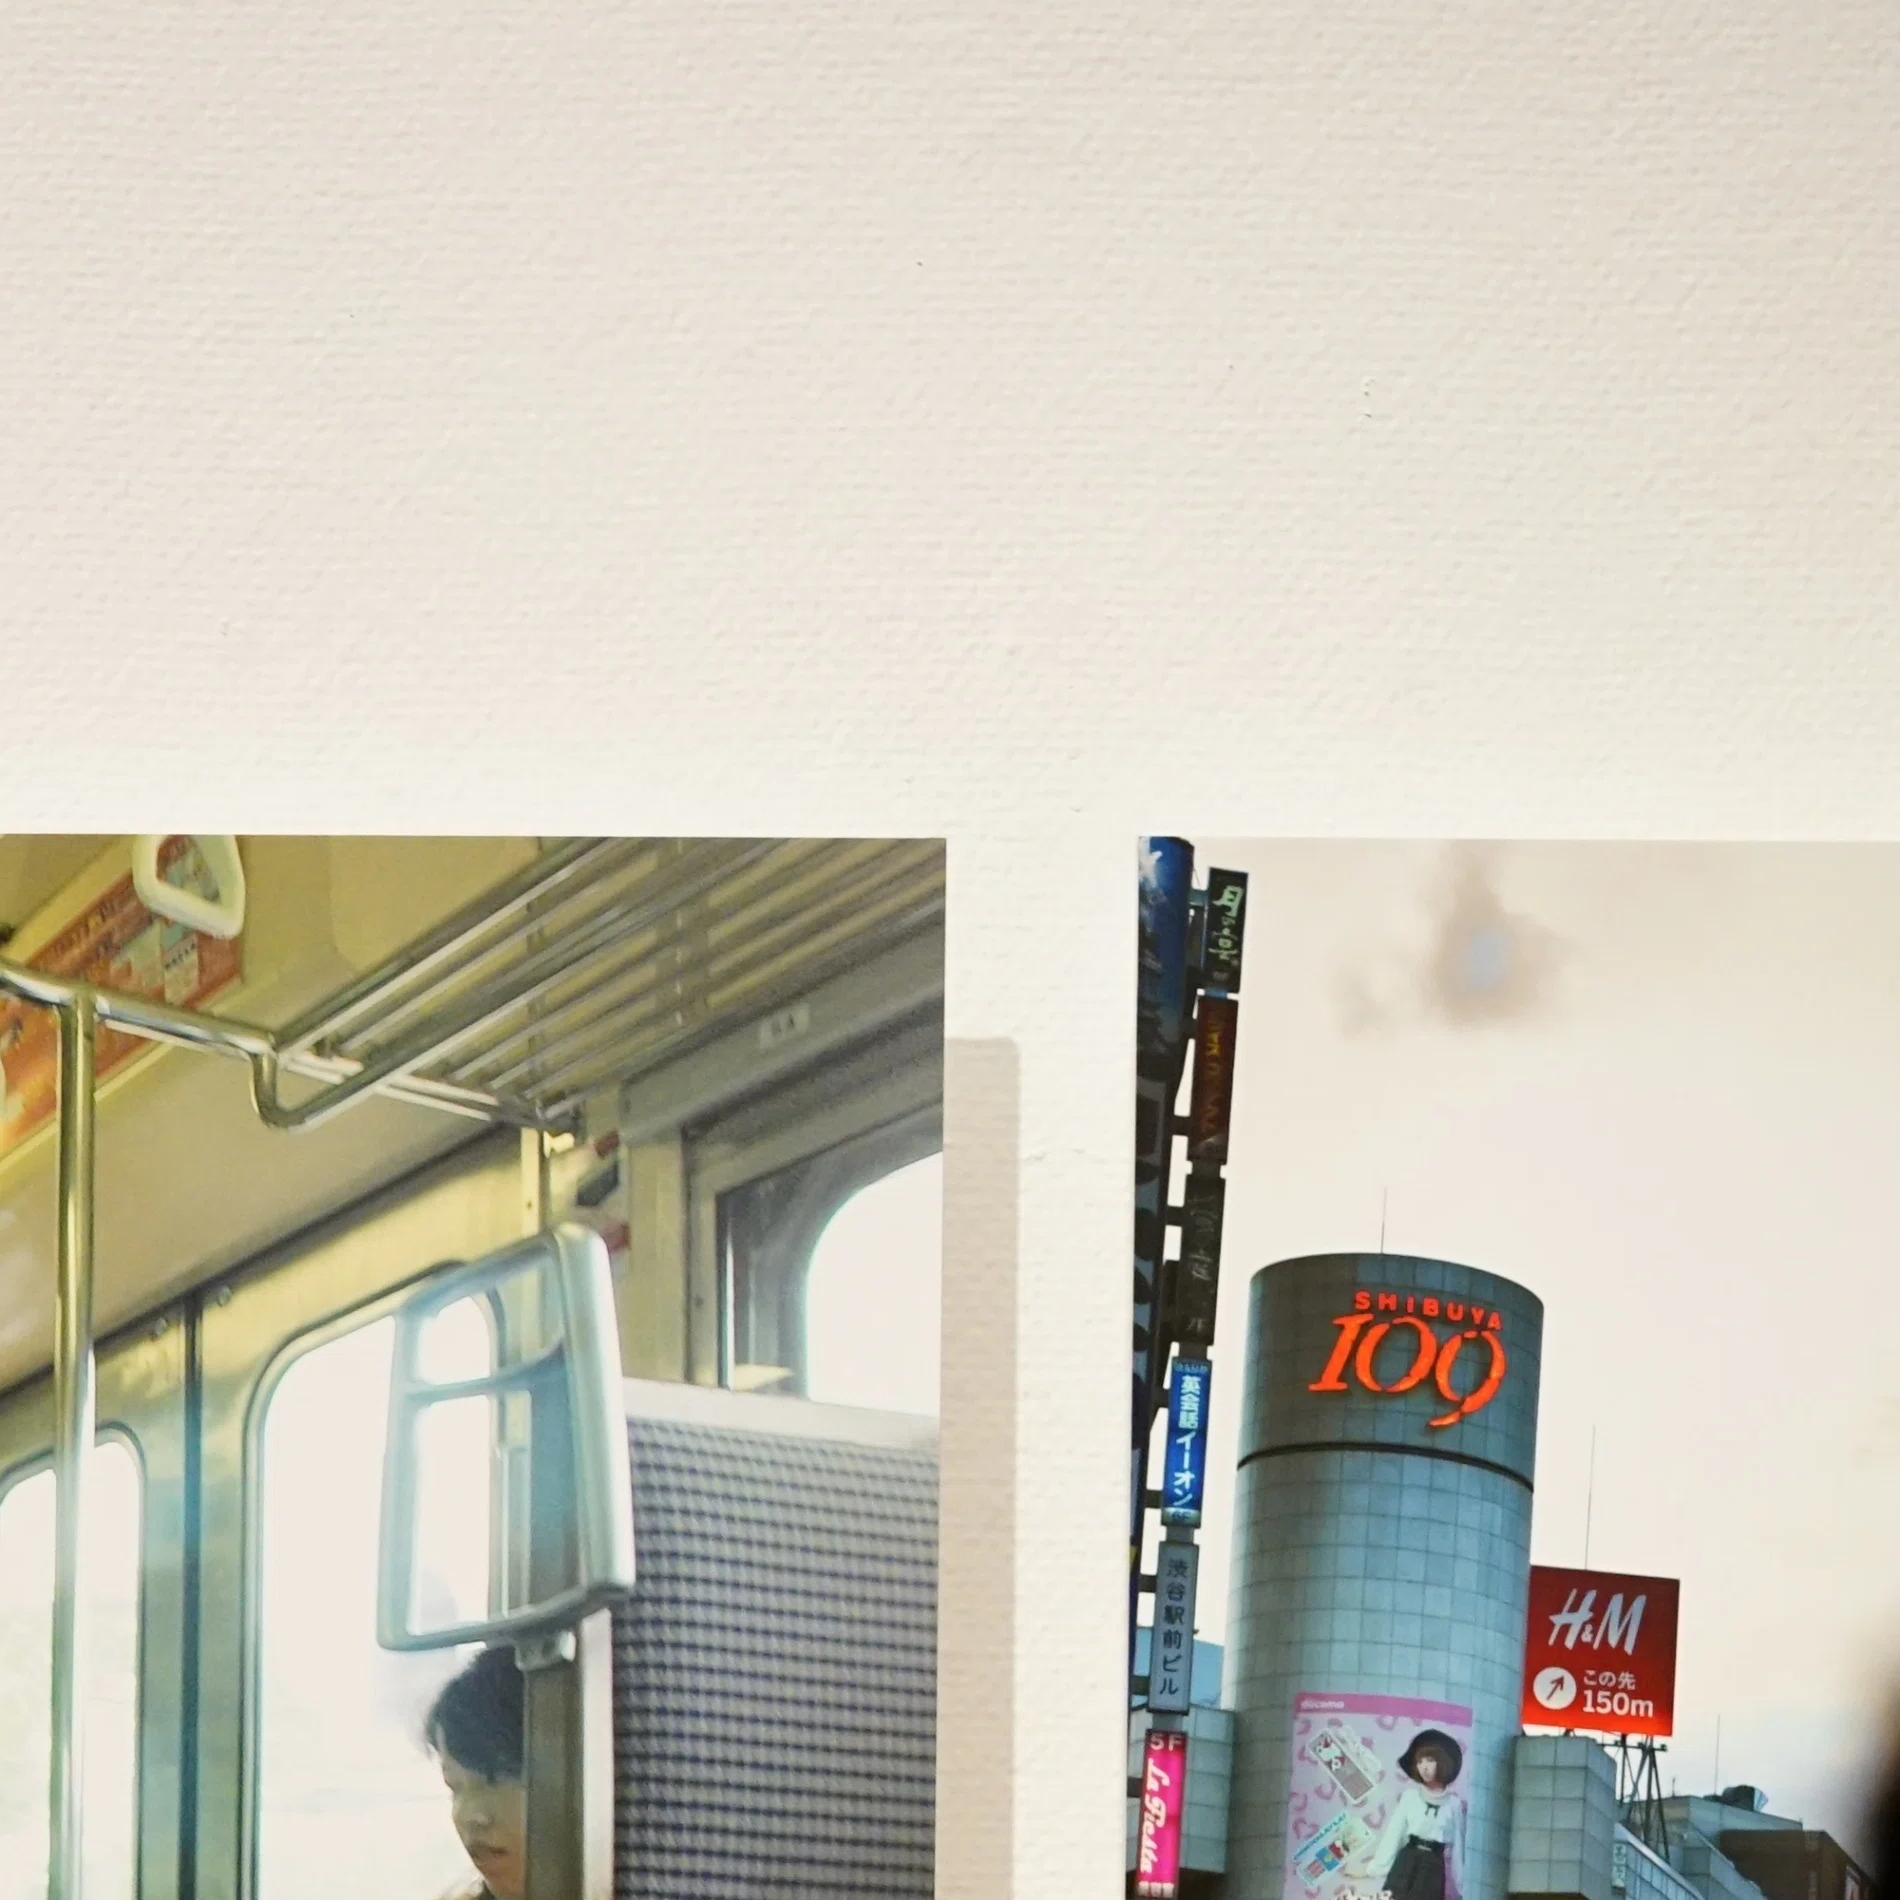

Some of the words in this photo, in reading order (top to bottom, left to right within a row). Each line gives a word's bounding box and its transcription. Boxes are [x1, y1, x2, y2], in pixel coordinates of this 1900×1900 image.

[1354, 1289, 1504, 1331] SHIBUYA
[1307, 1312, 1508, 1429] 109
[1173, 1375, 1203, 1508] 英会話イーオン
[1158, 1558, 1189, 1697] 渋谷駅前ビル
[1548, 1588, 1648, 1656] H&M
[1582, 1669, 1636, 1691] この先
[1582, 1689, 1654, 1718] 150m
[1149, 1733, 1183, 1751] 5F
